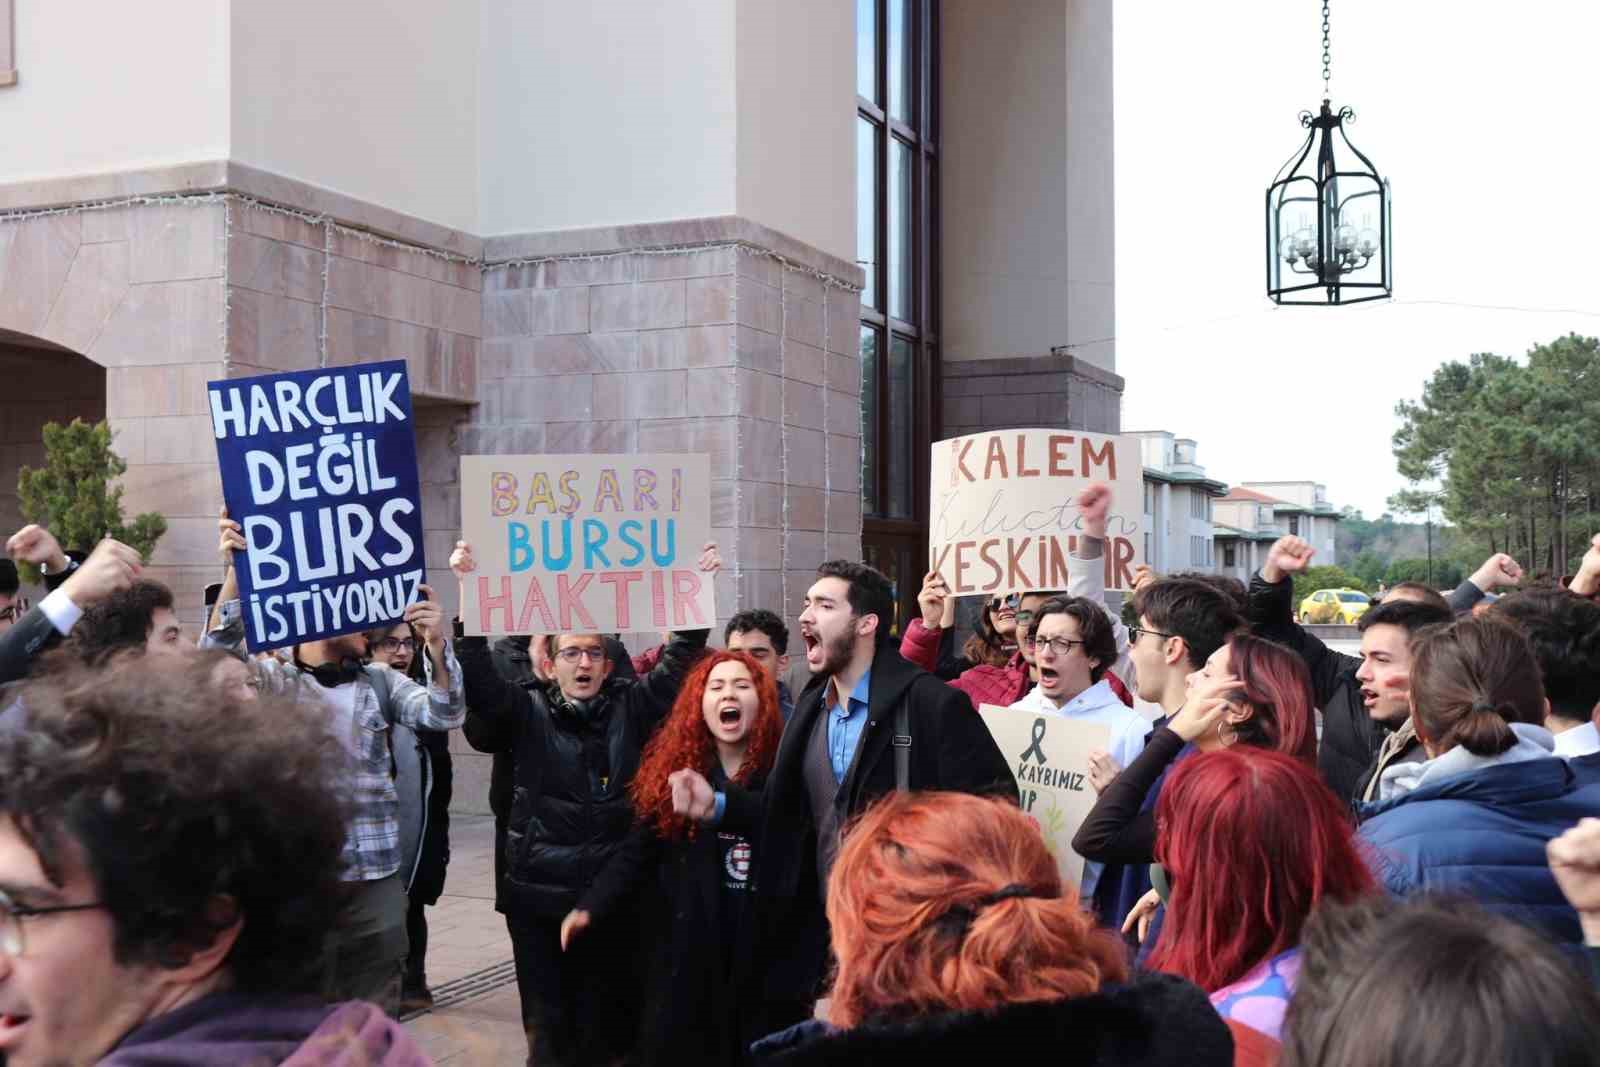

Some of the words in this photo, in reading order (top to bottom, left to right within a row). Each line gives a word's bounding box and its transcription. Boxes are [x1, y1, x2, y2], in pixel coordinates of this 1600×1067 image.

[209, 372, 406, 439] HARÇLIK
[245, 432, 396, 505] DEĞİL
[951, 434, 1117, 487] KALEM
[491, 468, 682, 519] BAŞARI
[243, 498, 415, 590] BURS
[507, 518, 676, 573] BURSU
[250, 569, 422, 643] İSTİYORUZ
[478, 570, 706, 633] HAKTIR
[1017, 763, 1086, 791] KAYBIMIZ
